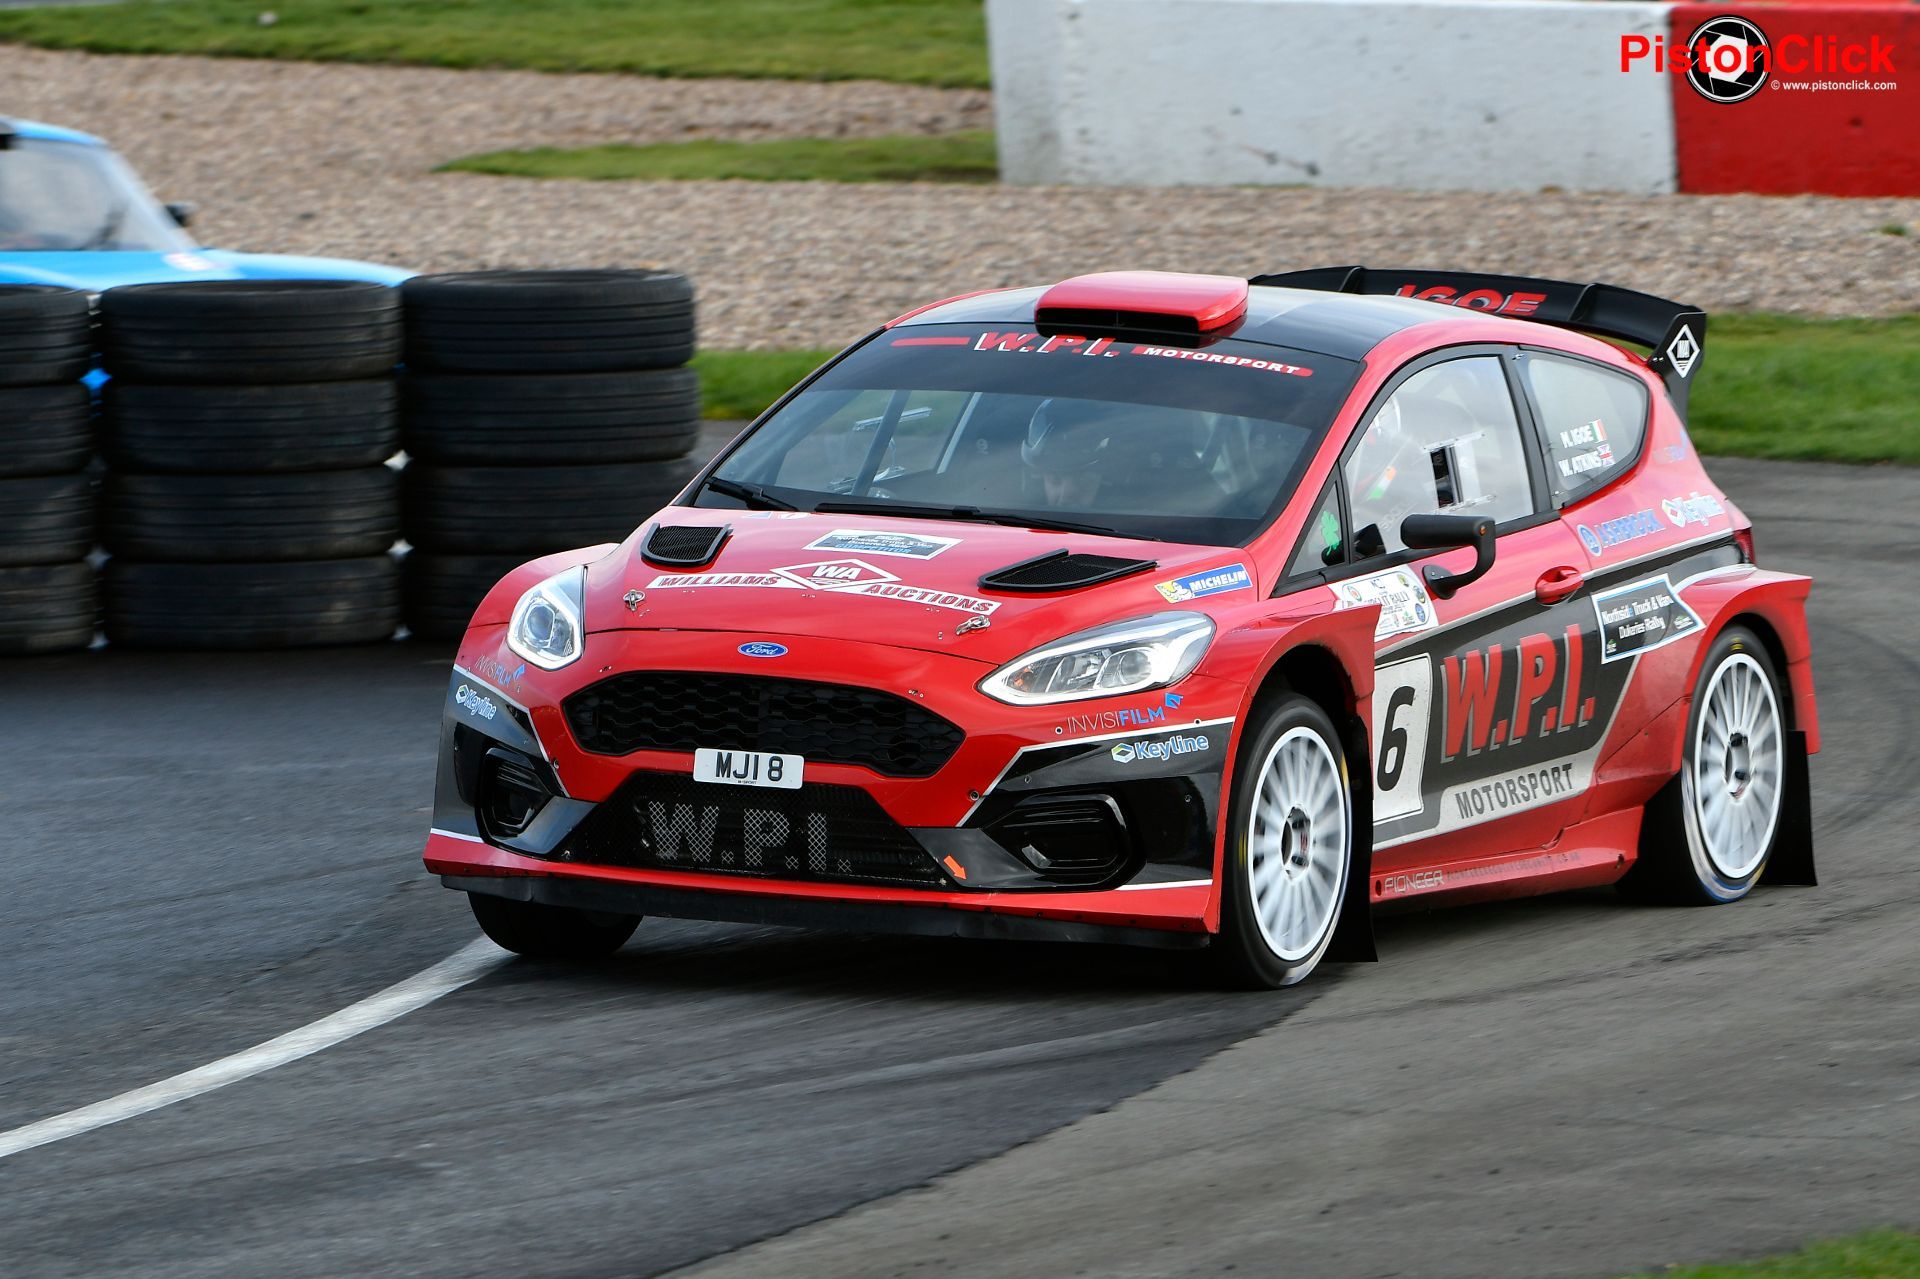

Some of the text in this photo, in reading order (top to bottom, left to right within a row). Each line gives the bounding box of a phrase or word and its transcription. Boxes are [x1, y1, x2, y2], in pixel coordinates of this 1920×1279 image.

[1395, 284, 1547, 316] IGOE
[973, 331, 1300, 374] W.P.I. MOTORSPORT
[658, 575, 781, 587] WILLIAMS
[812, 565, 862, 580] WA
[1188, 570, 1248, 593] MICHELIN
[863, 584, 994, 613] AUCTIONS
[746, 644, 779, 655] Ford
[463, 688, 497, 720] Keyline
[1440, 623, 1596, 764] W.P.I.
[1066, 706, 1166, 735] INVISIFILM
[1134, 734, 1209, 761] Keyline
[1376, 685, 1417, 792] 6
[767, 755, 784, 782] 8
[1455, 762, 1573, 820] MOTORSPORT
[648, 800, 852, 874] W.P.I.
[1383, 869, 1445, 895] PIONEER
